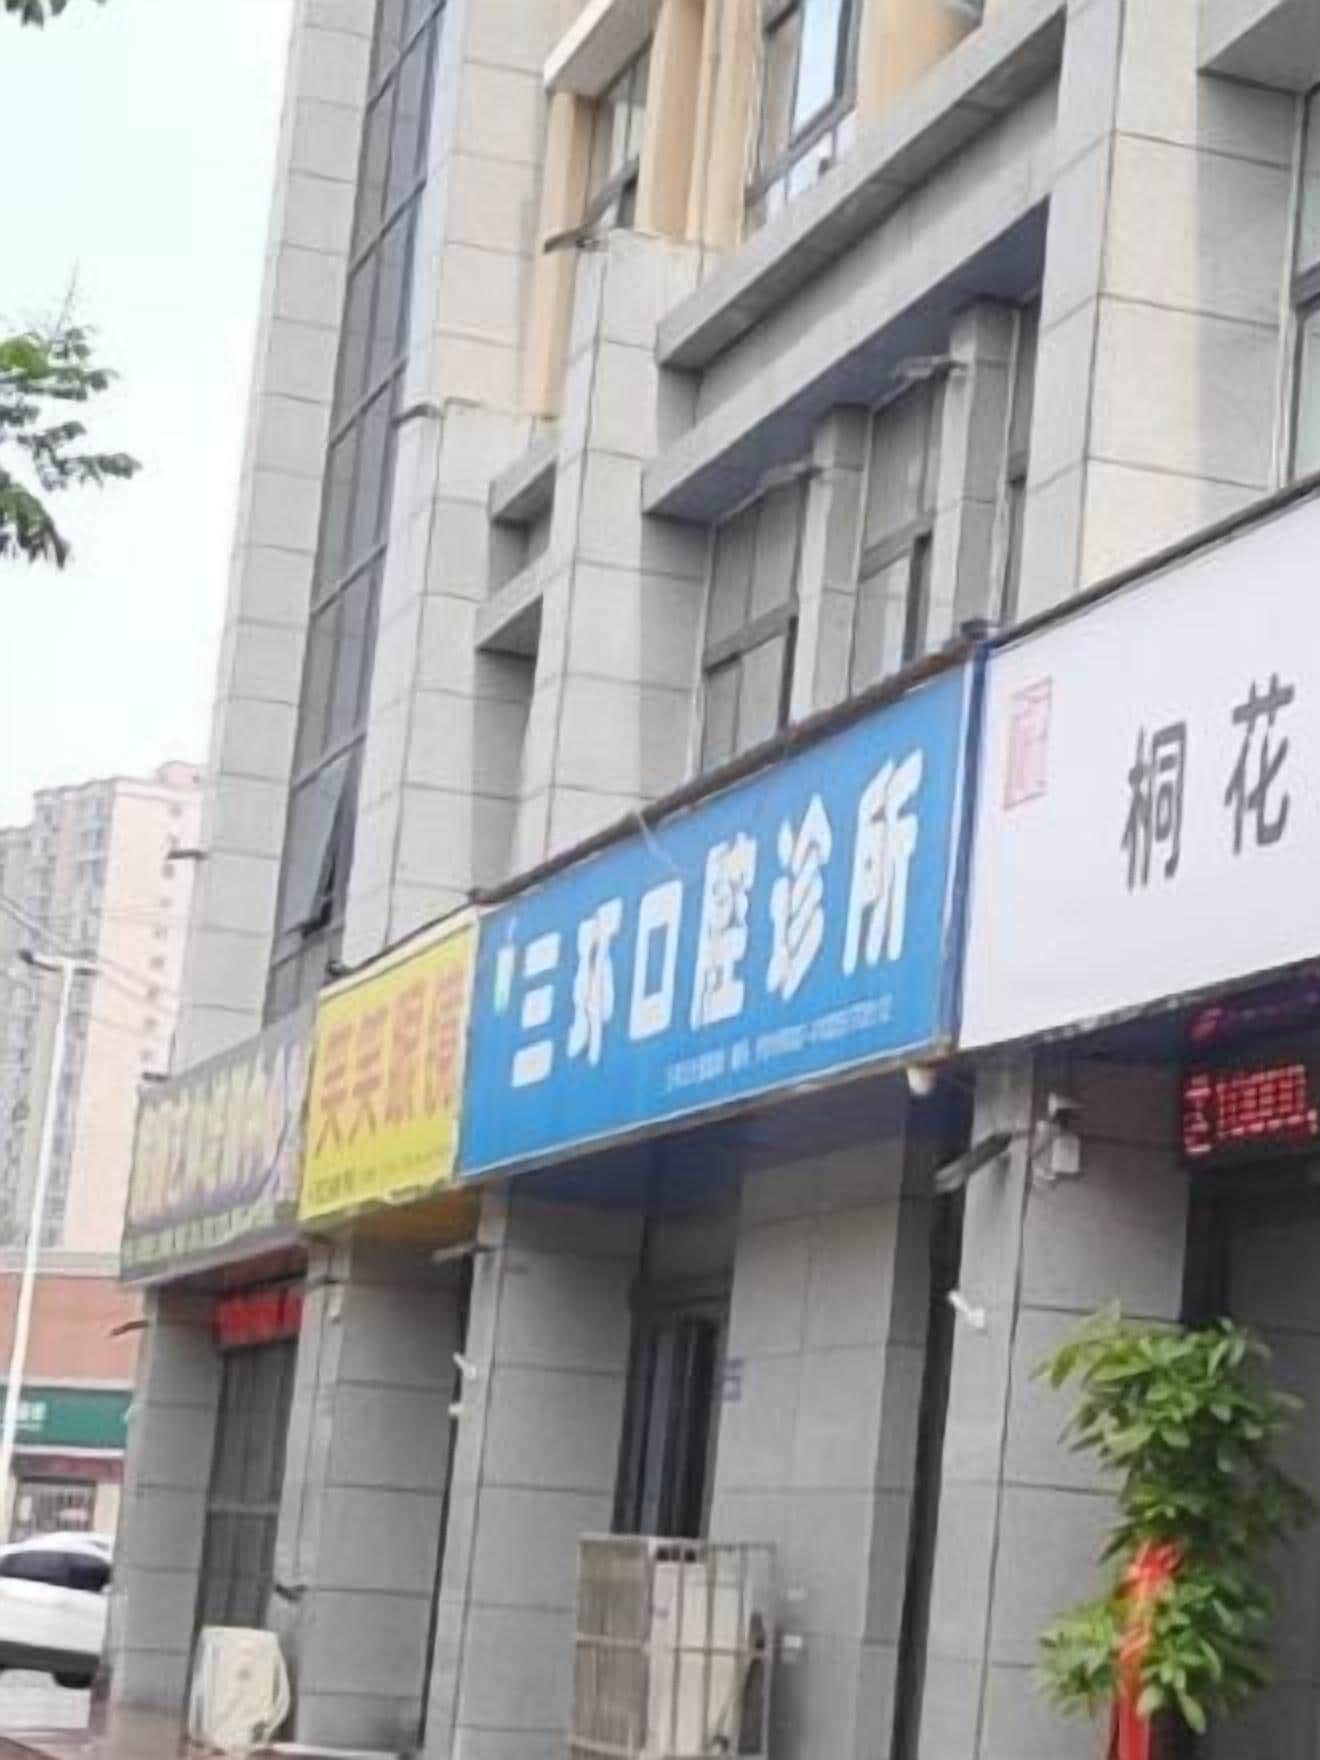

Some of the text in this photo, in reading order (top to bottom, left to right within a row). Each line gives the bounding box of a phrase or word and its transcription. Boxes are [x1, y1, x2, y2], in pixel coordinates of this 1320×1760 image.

[510, 747, 925, 1089] 三环口腔诊所
